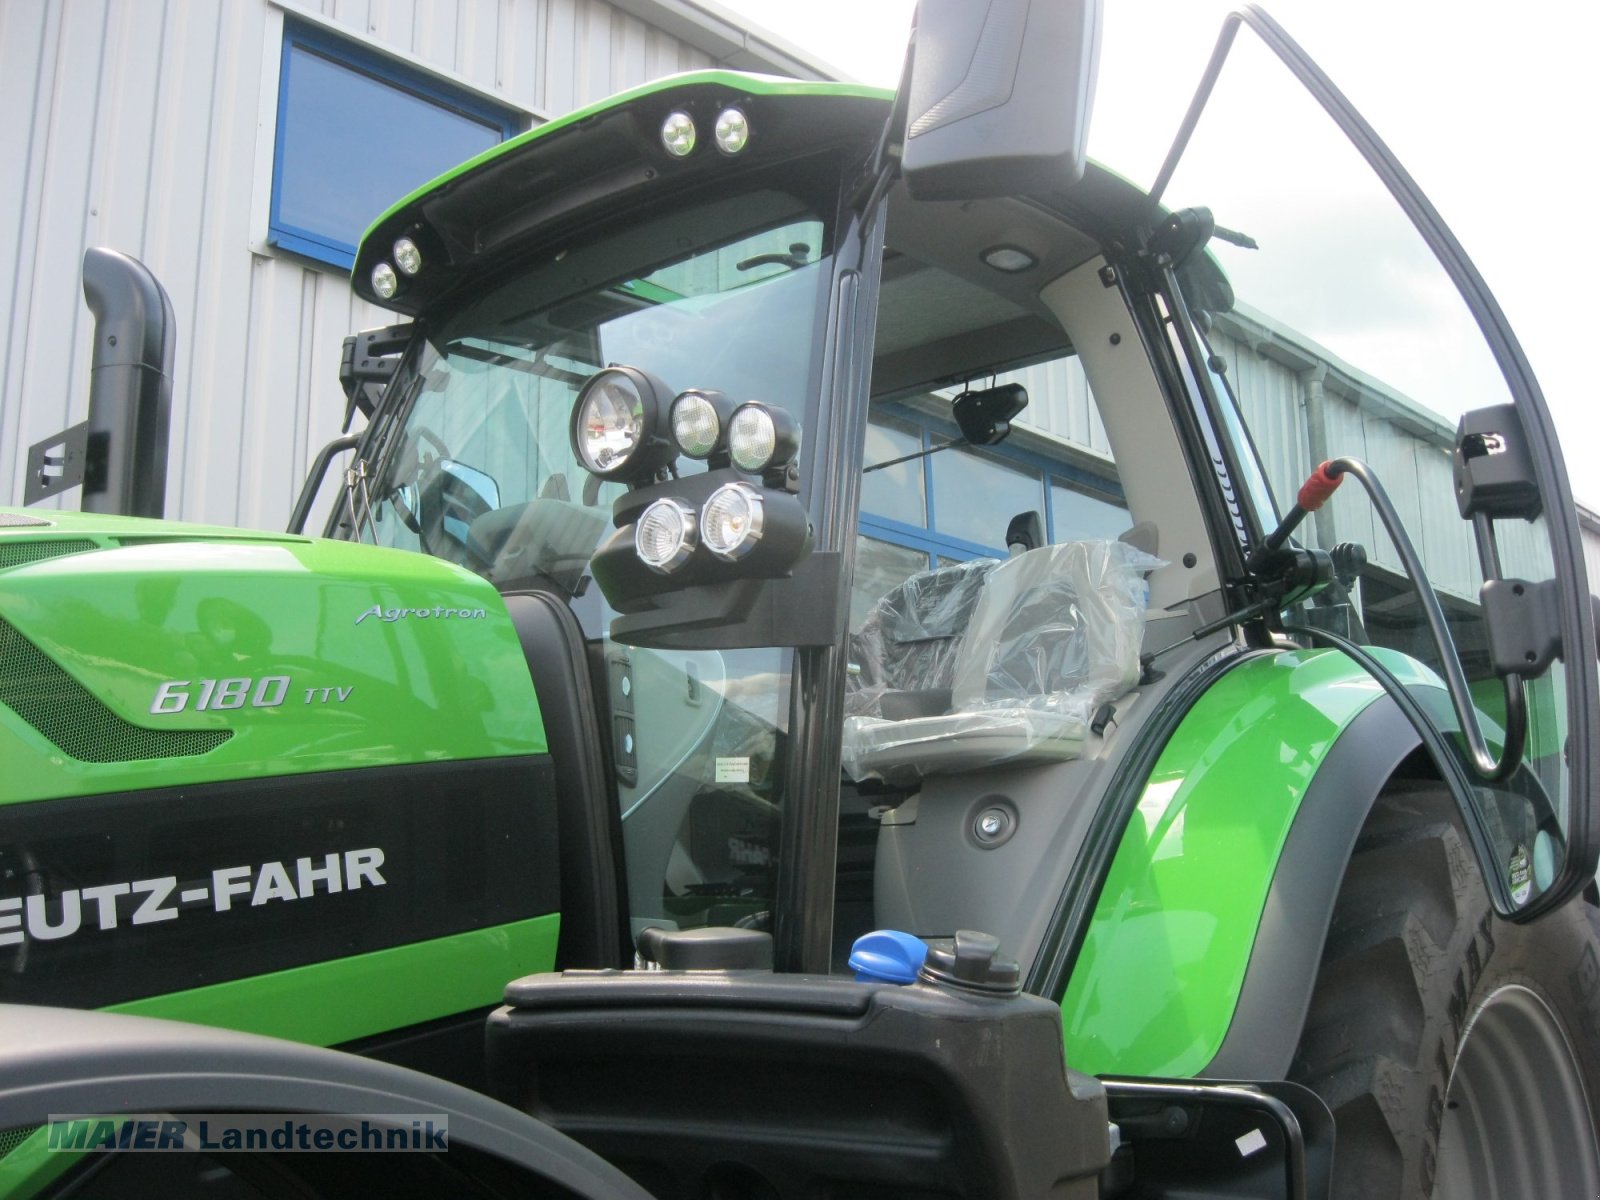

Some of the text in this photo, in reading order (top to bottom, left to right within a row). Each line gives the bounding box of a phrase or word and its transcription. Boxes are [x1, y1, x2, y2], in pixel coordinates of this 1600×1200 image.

[355, 604, 487, 626] Agrotron
[150, 674, 354, 715] 6180 TTV
